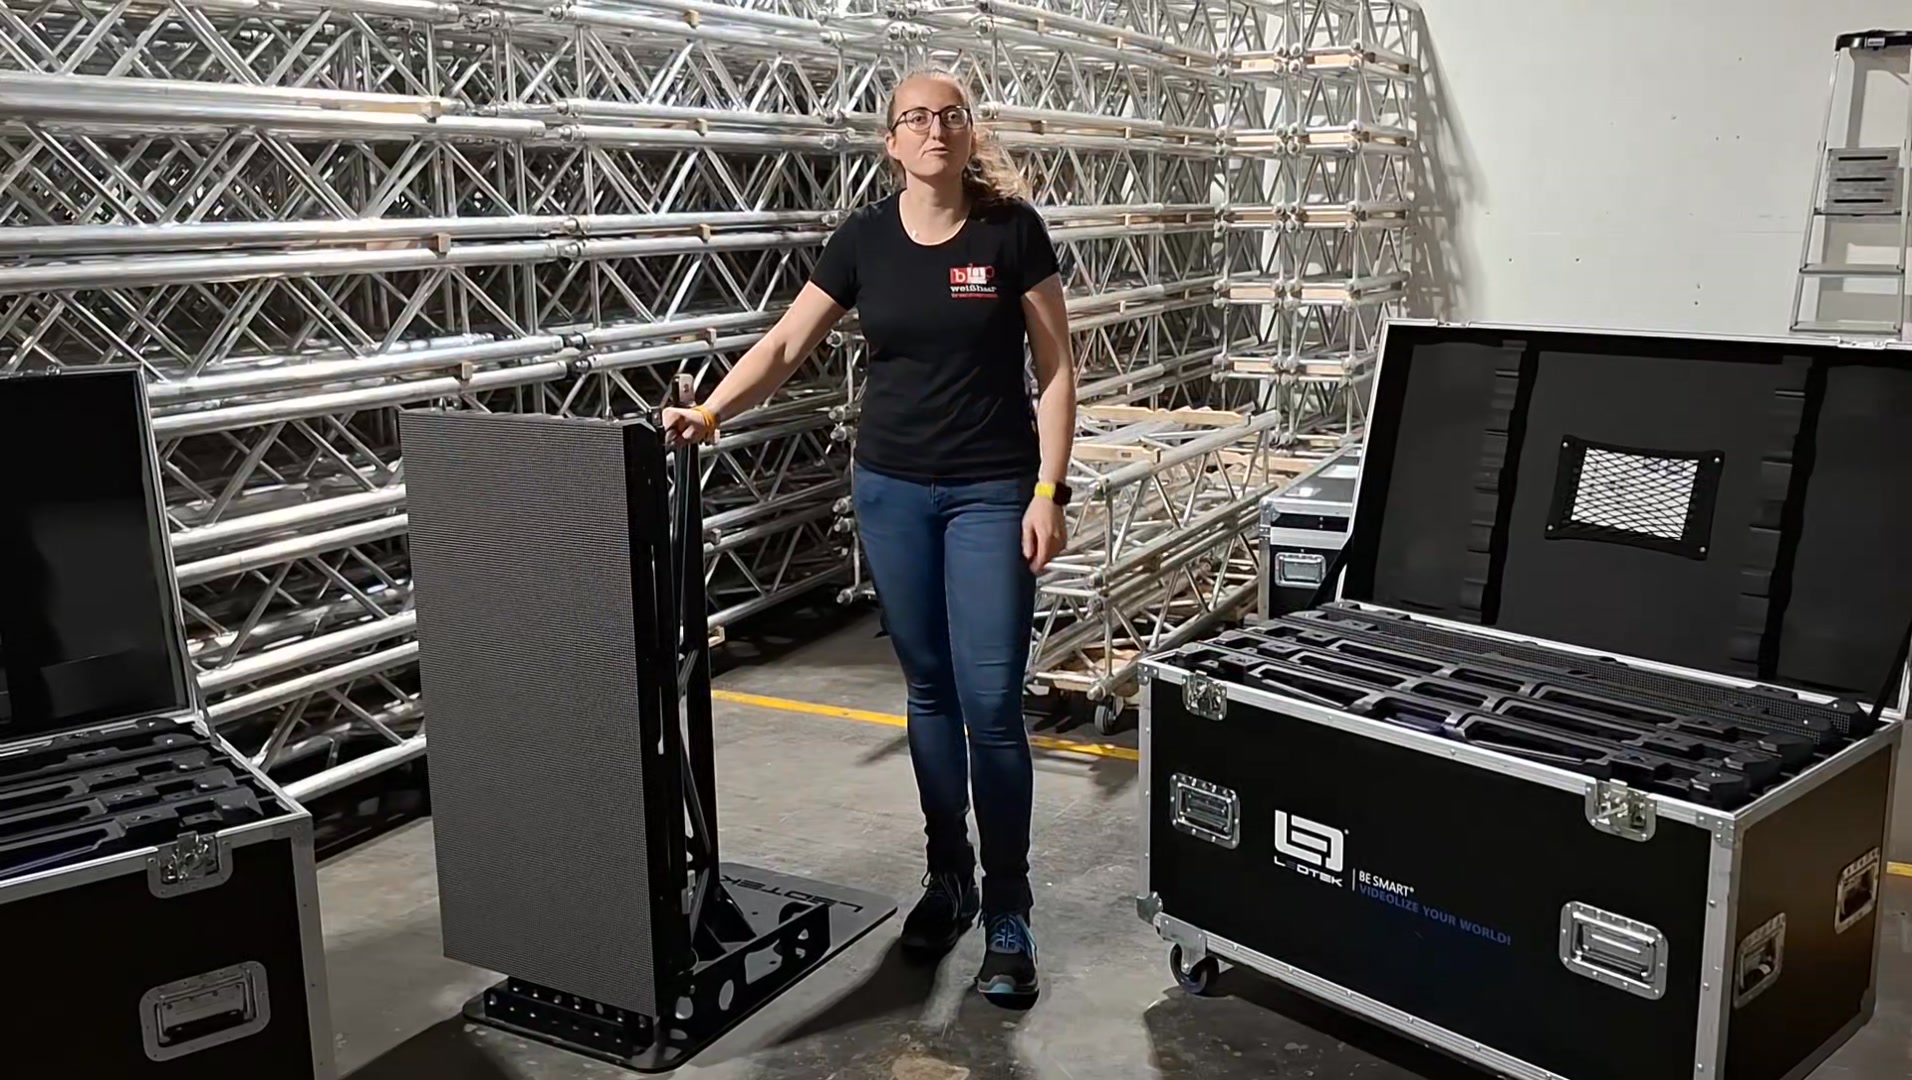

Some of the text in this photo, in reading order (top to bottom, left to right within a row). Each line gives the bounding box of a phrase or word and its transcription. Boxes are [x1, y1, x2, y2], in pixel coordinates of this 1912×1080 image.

[1359, 870, 1371, 884] BE
[1359, 883, 1511, 945] VIDEOLIZE YOUR WORLD!
